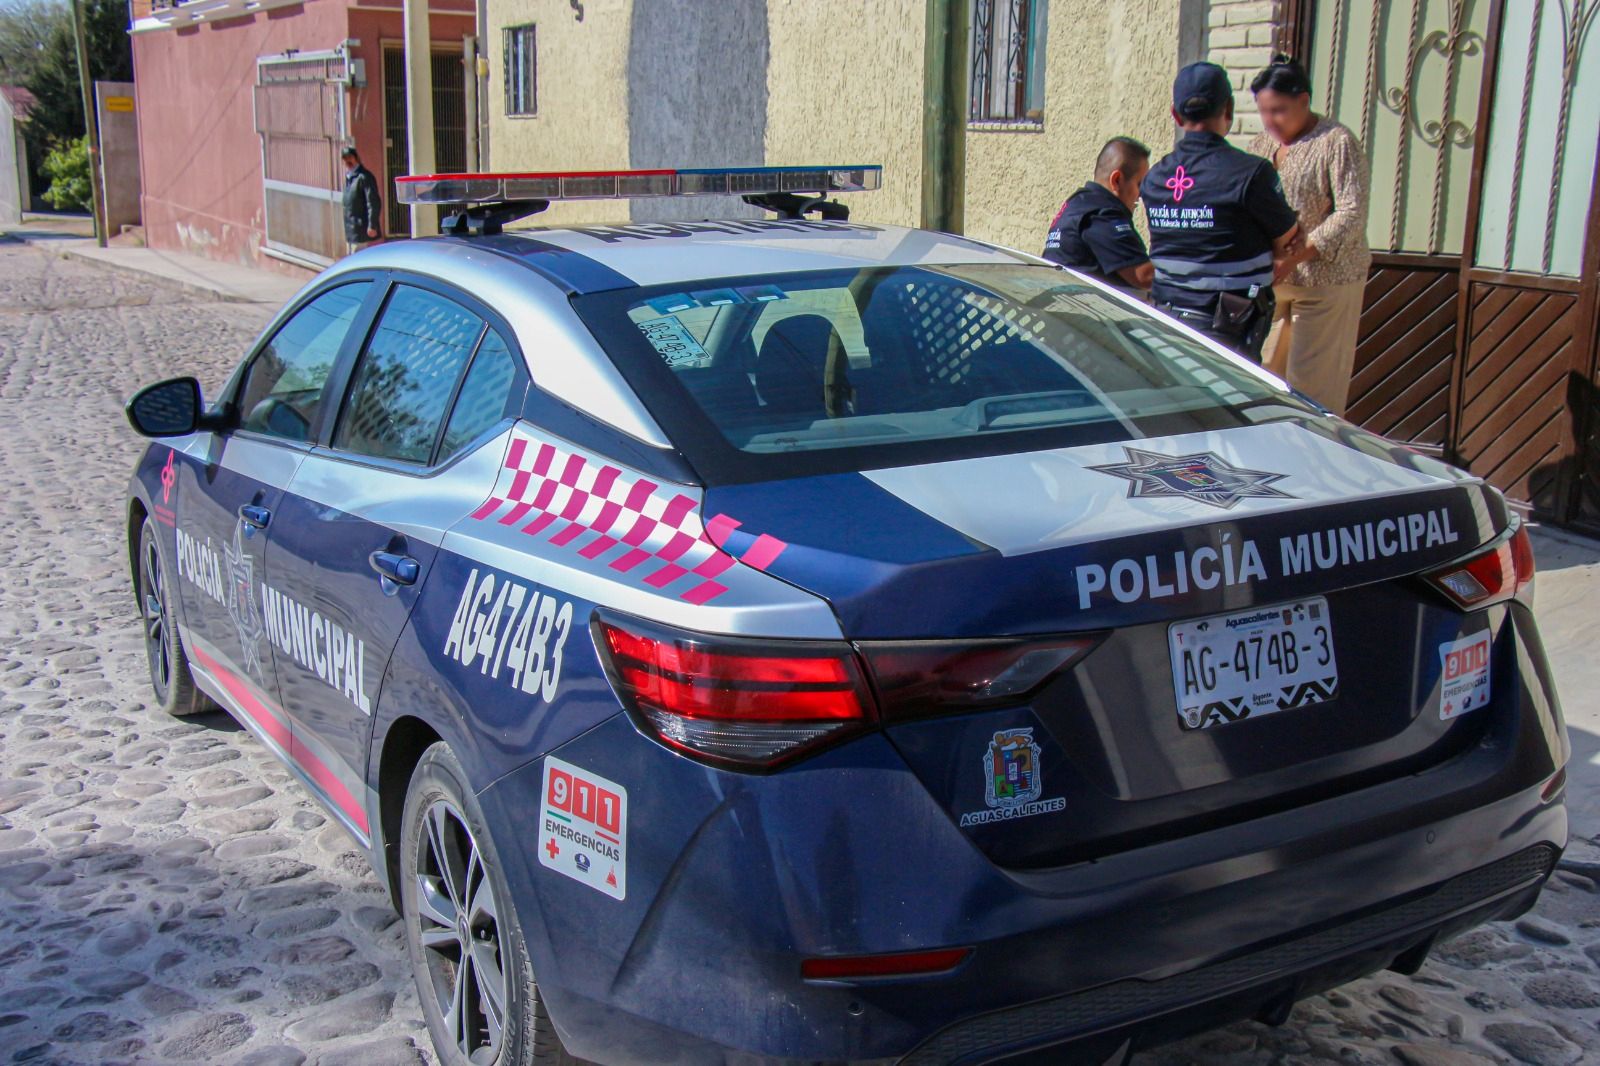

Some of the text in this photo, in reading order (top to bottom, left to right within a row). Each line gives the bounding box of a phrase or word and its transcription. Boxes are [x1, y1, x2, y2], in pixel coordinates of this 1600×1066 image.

[1170, 208, 1179, 218] DE
[1180, 204, 1214, 219] ATENCIÓN
[1190, 218, 1214, 228] Género
[1075, 508, 1459, 610] POLICÍA MUNICIPAL
[176, 528, 371, 717] POLICÍA MUNICIPAL
[443, 568, 573, 704] AG474B3
[1225, 611, 1280, 629] Aguascalientes
[1183, 625, 1331, 696] AG-474B-3
[1448, 646, 1485, 677] 911
[1444, 675, 1487, 699] EMERGENCIAS
[553, 777, 613, 826] 911
[960, 798, 1066, 826] AGUASCALIENTES
[545, 819, 620, 862] EMERGENCIAS
